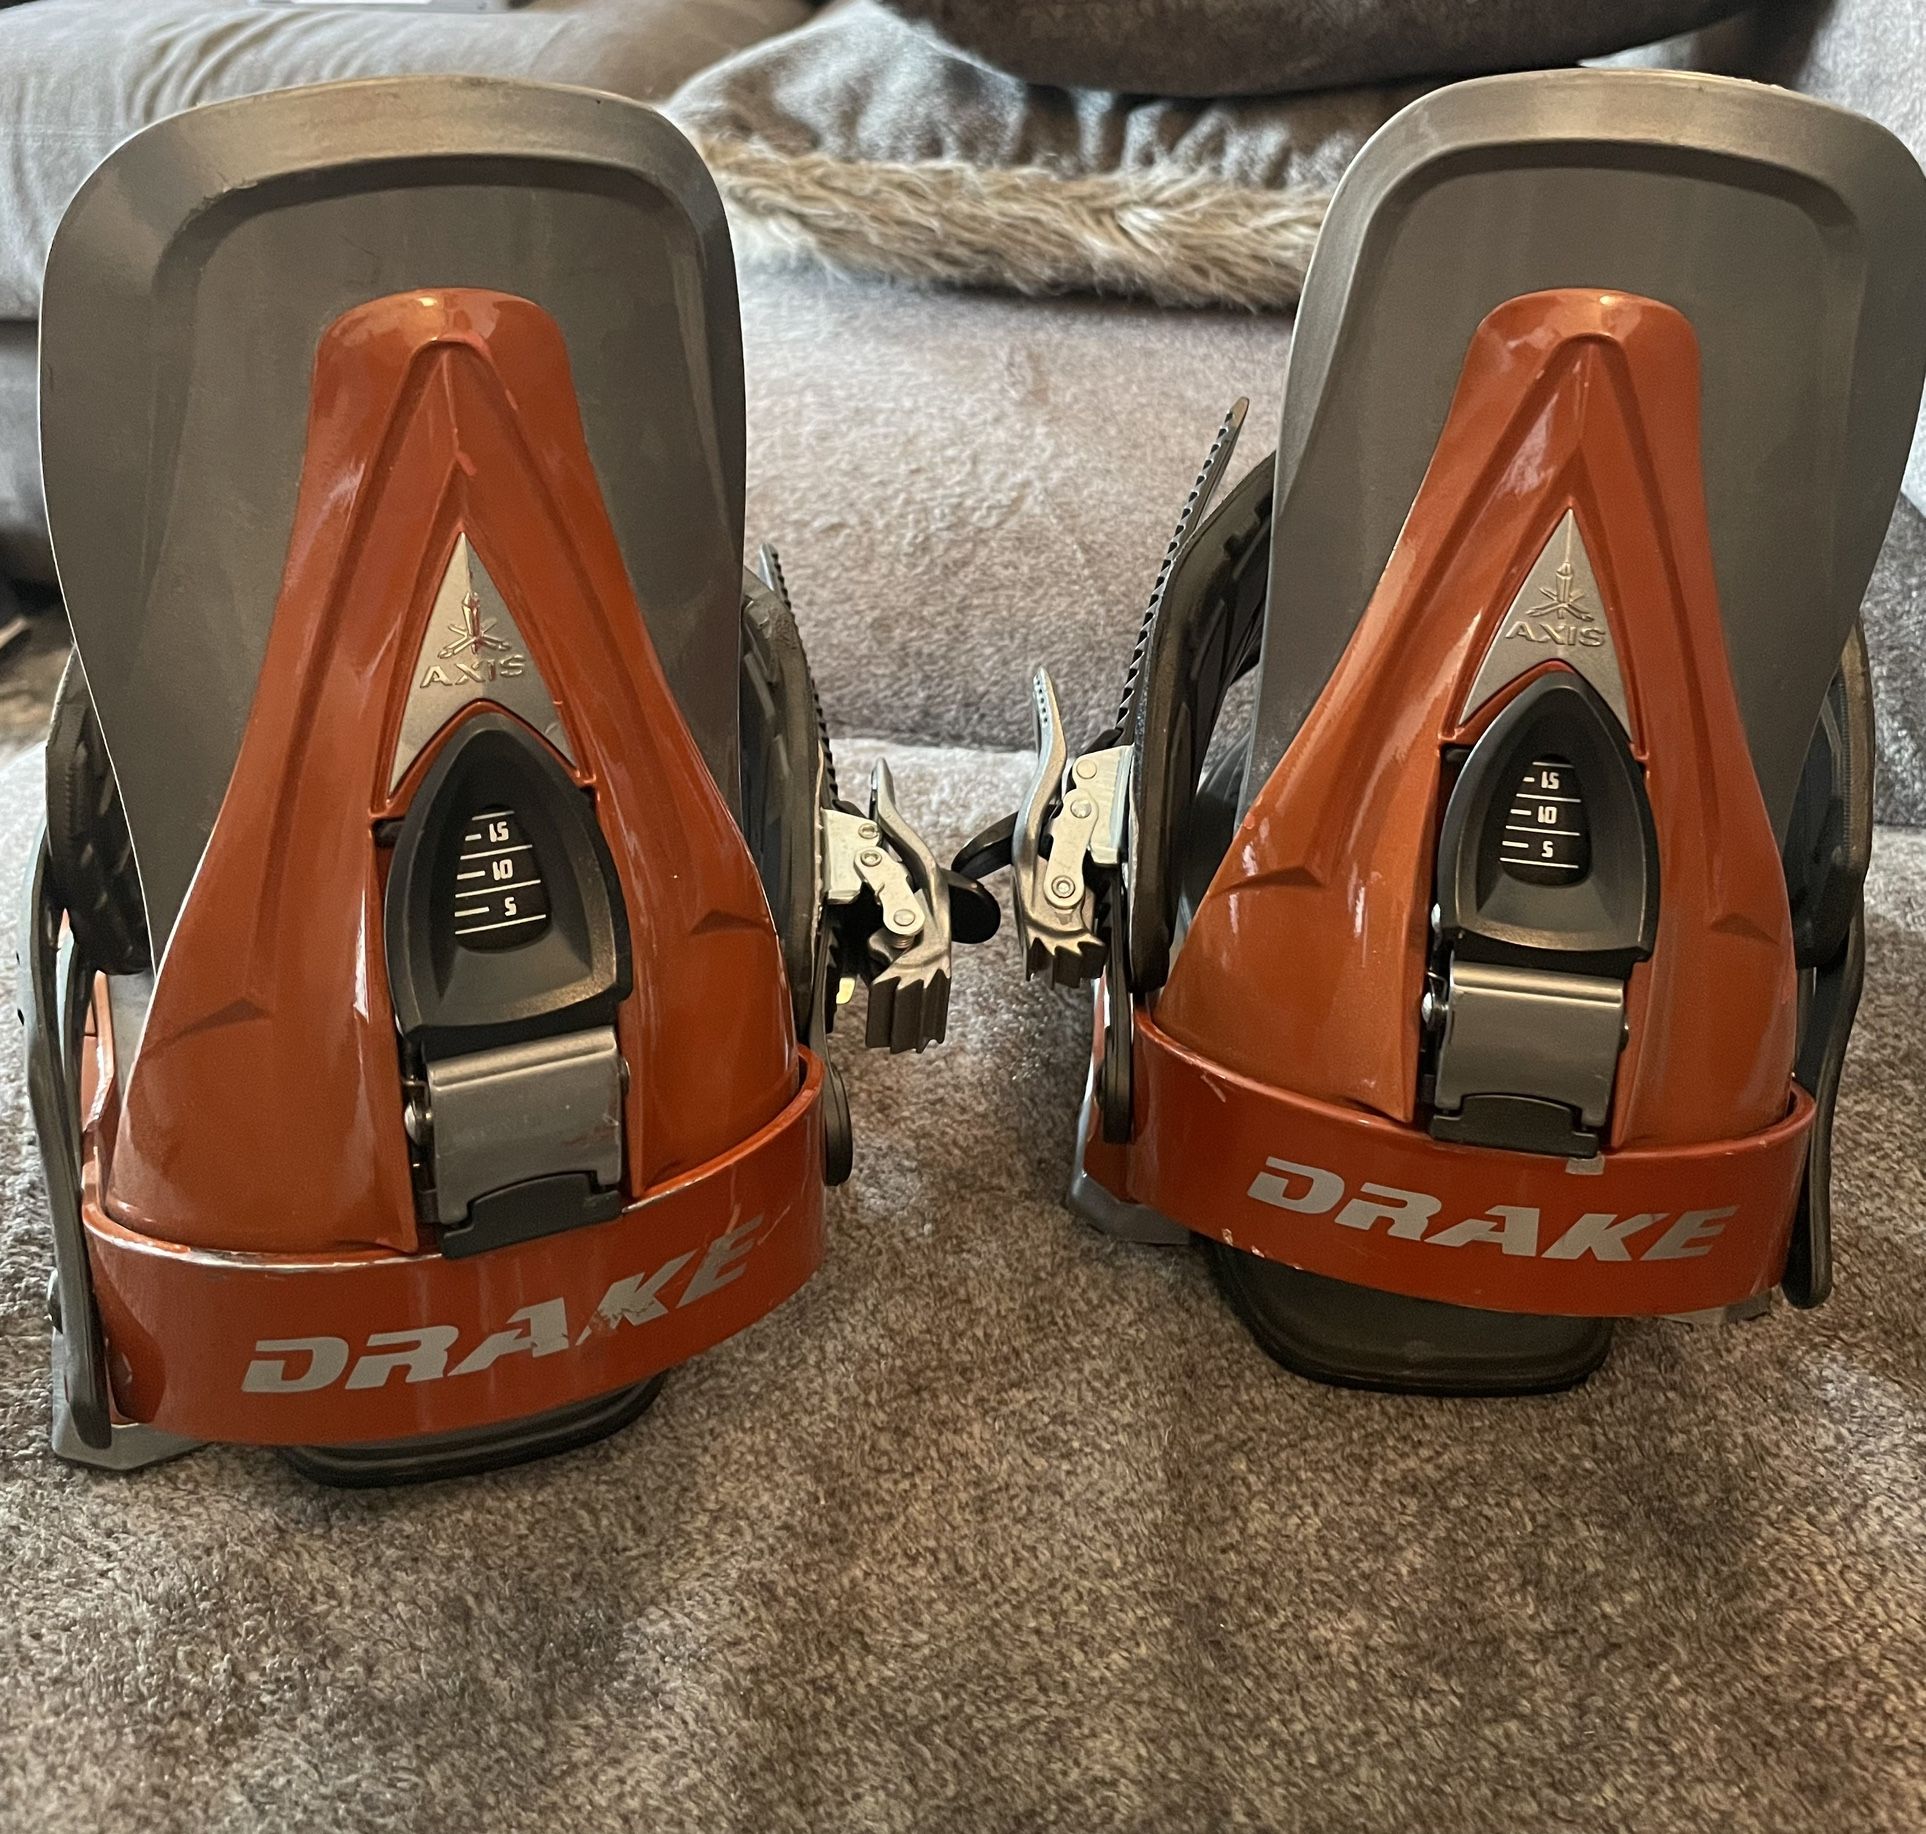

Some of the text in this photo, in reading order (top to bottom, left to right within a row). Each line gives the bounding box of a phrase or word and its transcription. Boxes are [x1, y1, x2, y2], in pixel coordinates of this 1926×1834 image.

[1505, 620, 1606, 648] AXIS
[419, 653, 527, 689] AXIS
[1541, 770, 1560, 790] 15
[1537, 805, 1558, 825] 10
[488, 821, 510, 843] 15
[1541, 840, 1554, 859] 5
[492, 858, 514, 881] 10
[504, 896, 517, 917] 5
[1246, 1155, 1739, 1262] DRAKE
[241, 1215, 764, 1393] DRAKE
